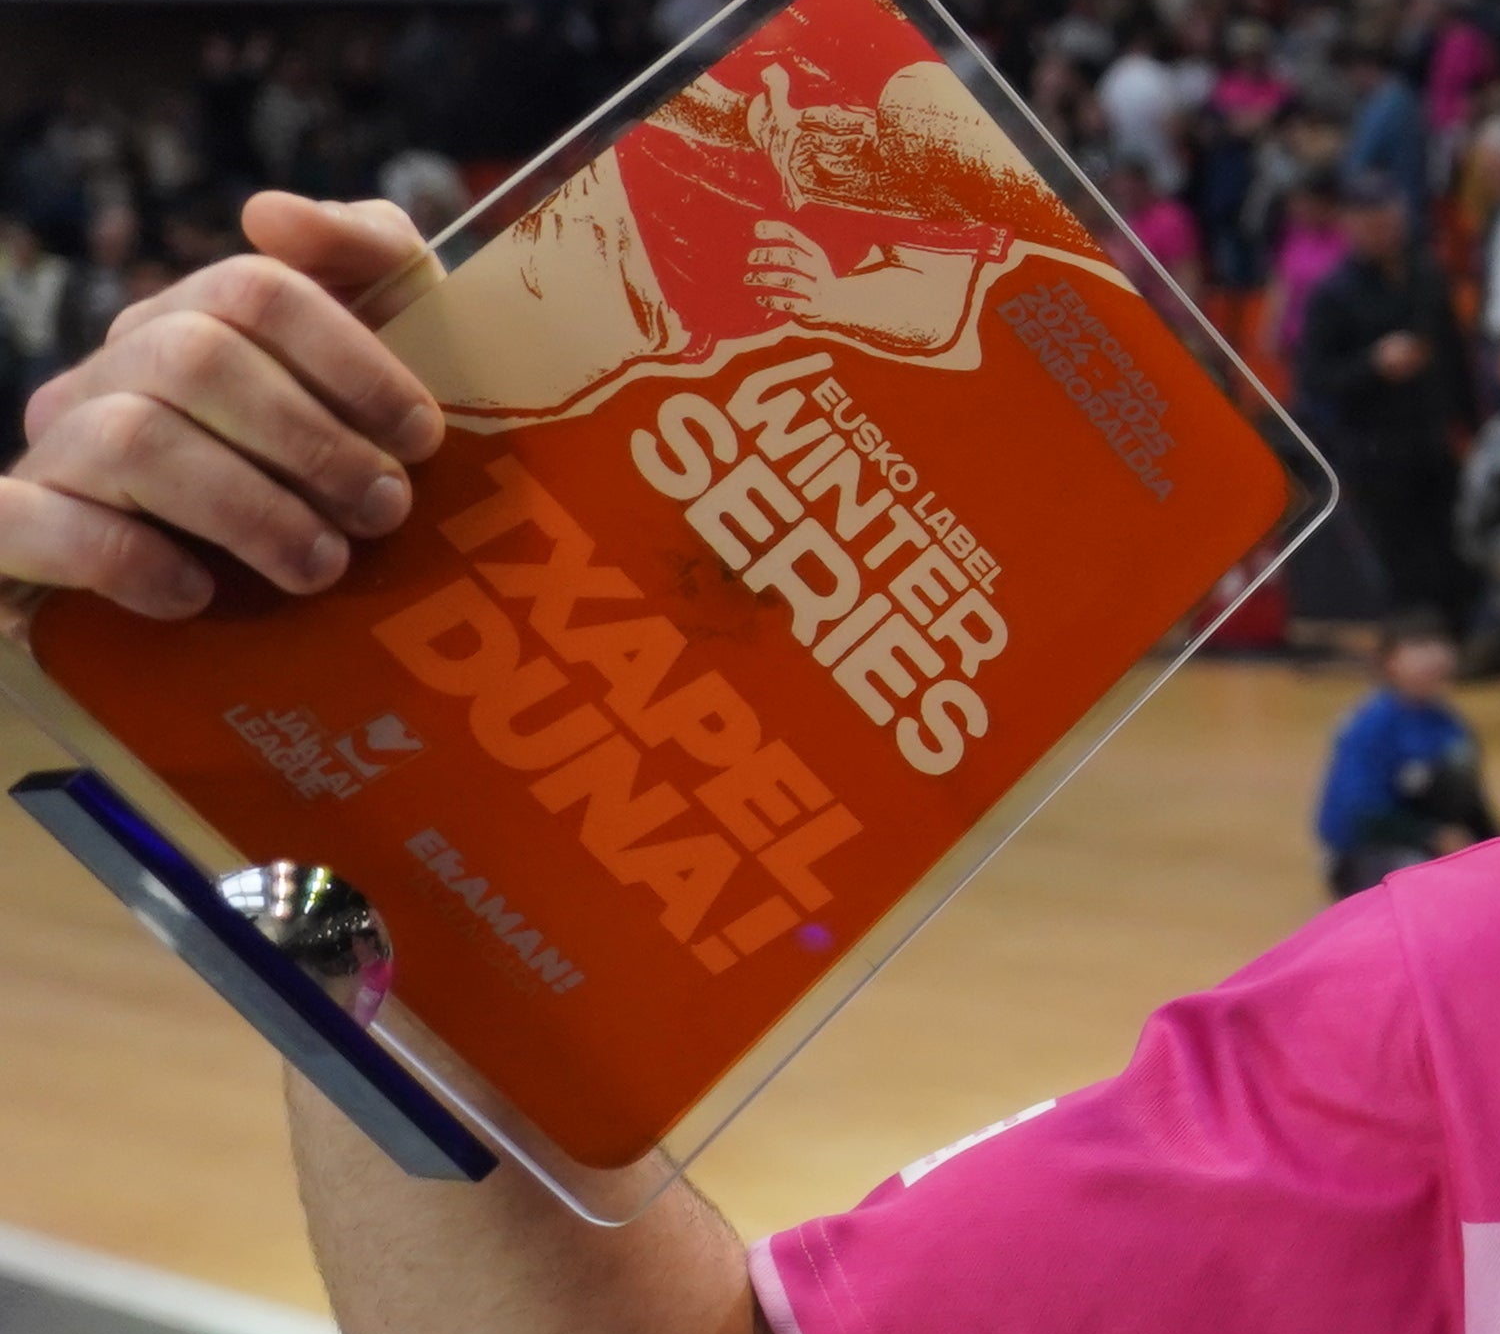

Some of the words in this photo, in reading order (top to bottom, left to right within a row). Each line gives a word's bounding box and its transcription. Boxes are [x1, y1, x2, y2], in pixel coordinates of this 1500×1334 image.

[995, 297, 1174, 503] DENBORALDIA
[1018, 283, 1098, 365] 2024
[1100, 379, 1177, 457] 2025
[1050, 277, 1169, 416] TEMPORADA
[630, 392, 989, 775] SERIES
[725, 351, 1009, 678] WINTER
[811, 375, 918, 493] EUSKO
[912, 490, 1002, 595] LABEL
[370, 575, 802, 976] DUNA!
[436, 453, 865, 913] TXAPEL
